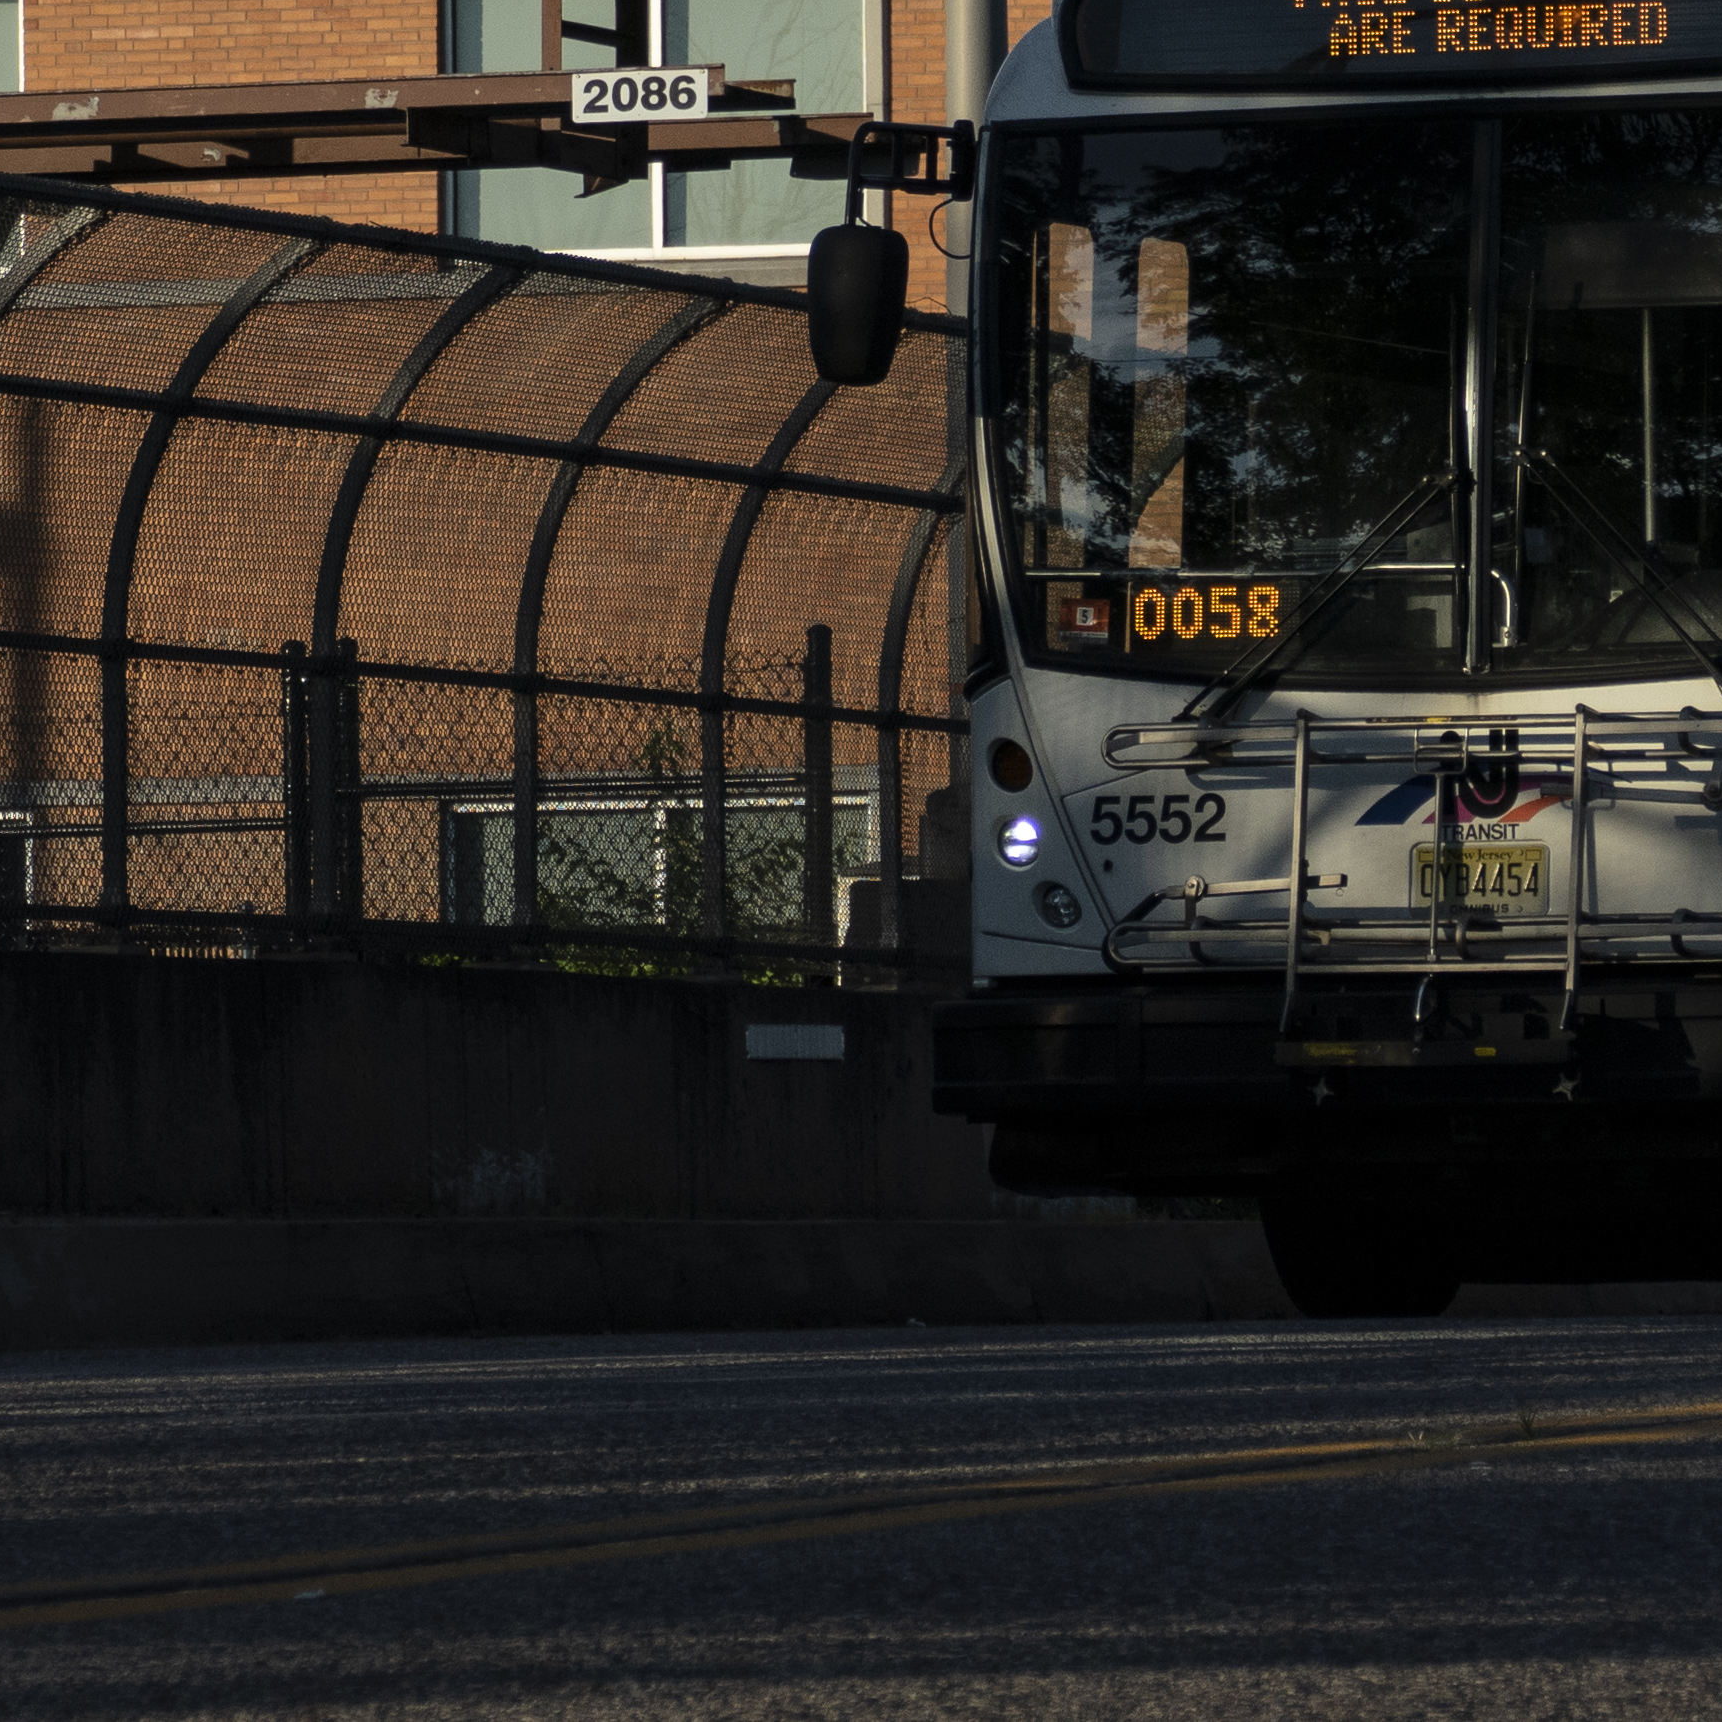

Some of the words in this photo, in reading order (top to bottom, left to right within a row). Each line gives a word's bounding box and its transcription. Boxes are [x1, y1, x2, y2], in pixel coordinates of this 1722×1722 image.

[1328, 8, 1418, 58] ARE
[1435, 1, 1670, 53] REQUIRED
[582, 74, 698, 114] 2086
[1134, 585, 1280, 640] 0058
[1090, 793, 1227, 845] 5552
[1441, 823, 1520, 841] TRANSIT
[1446, 848, 1476, 861] New
[1476, 848, 1514, 863] Jersey
[1449, 903, 1510, 916] OMNIBUS
